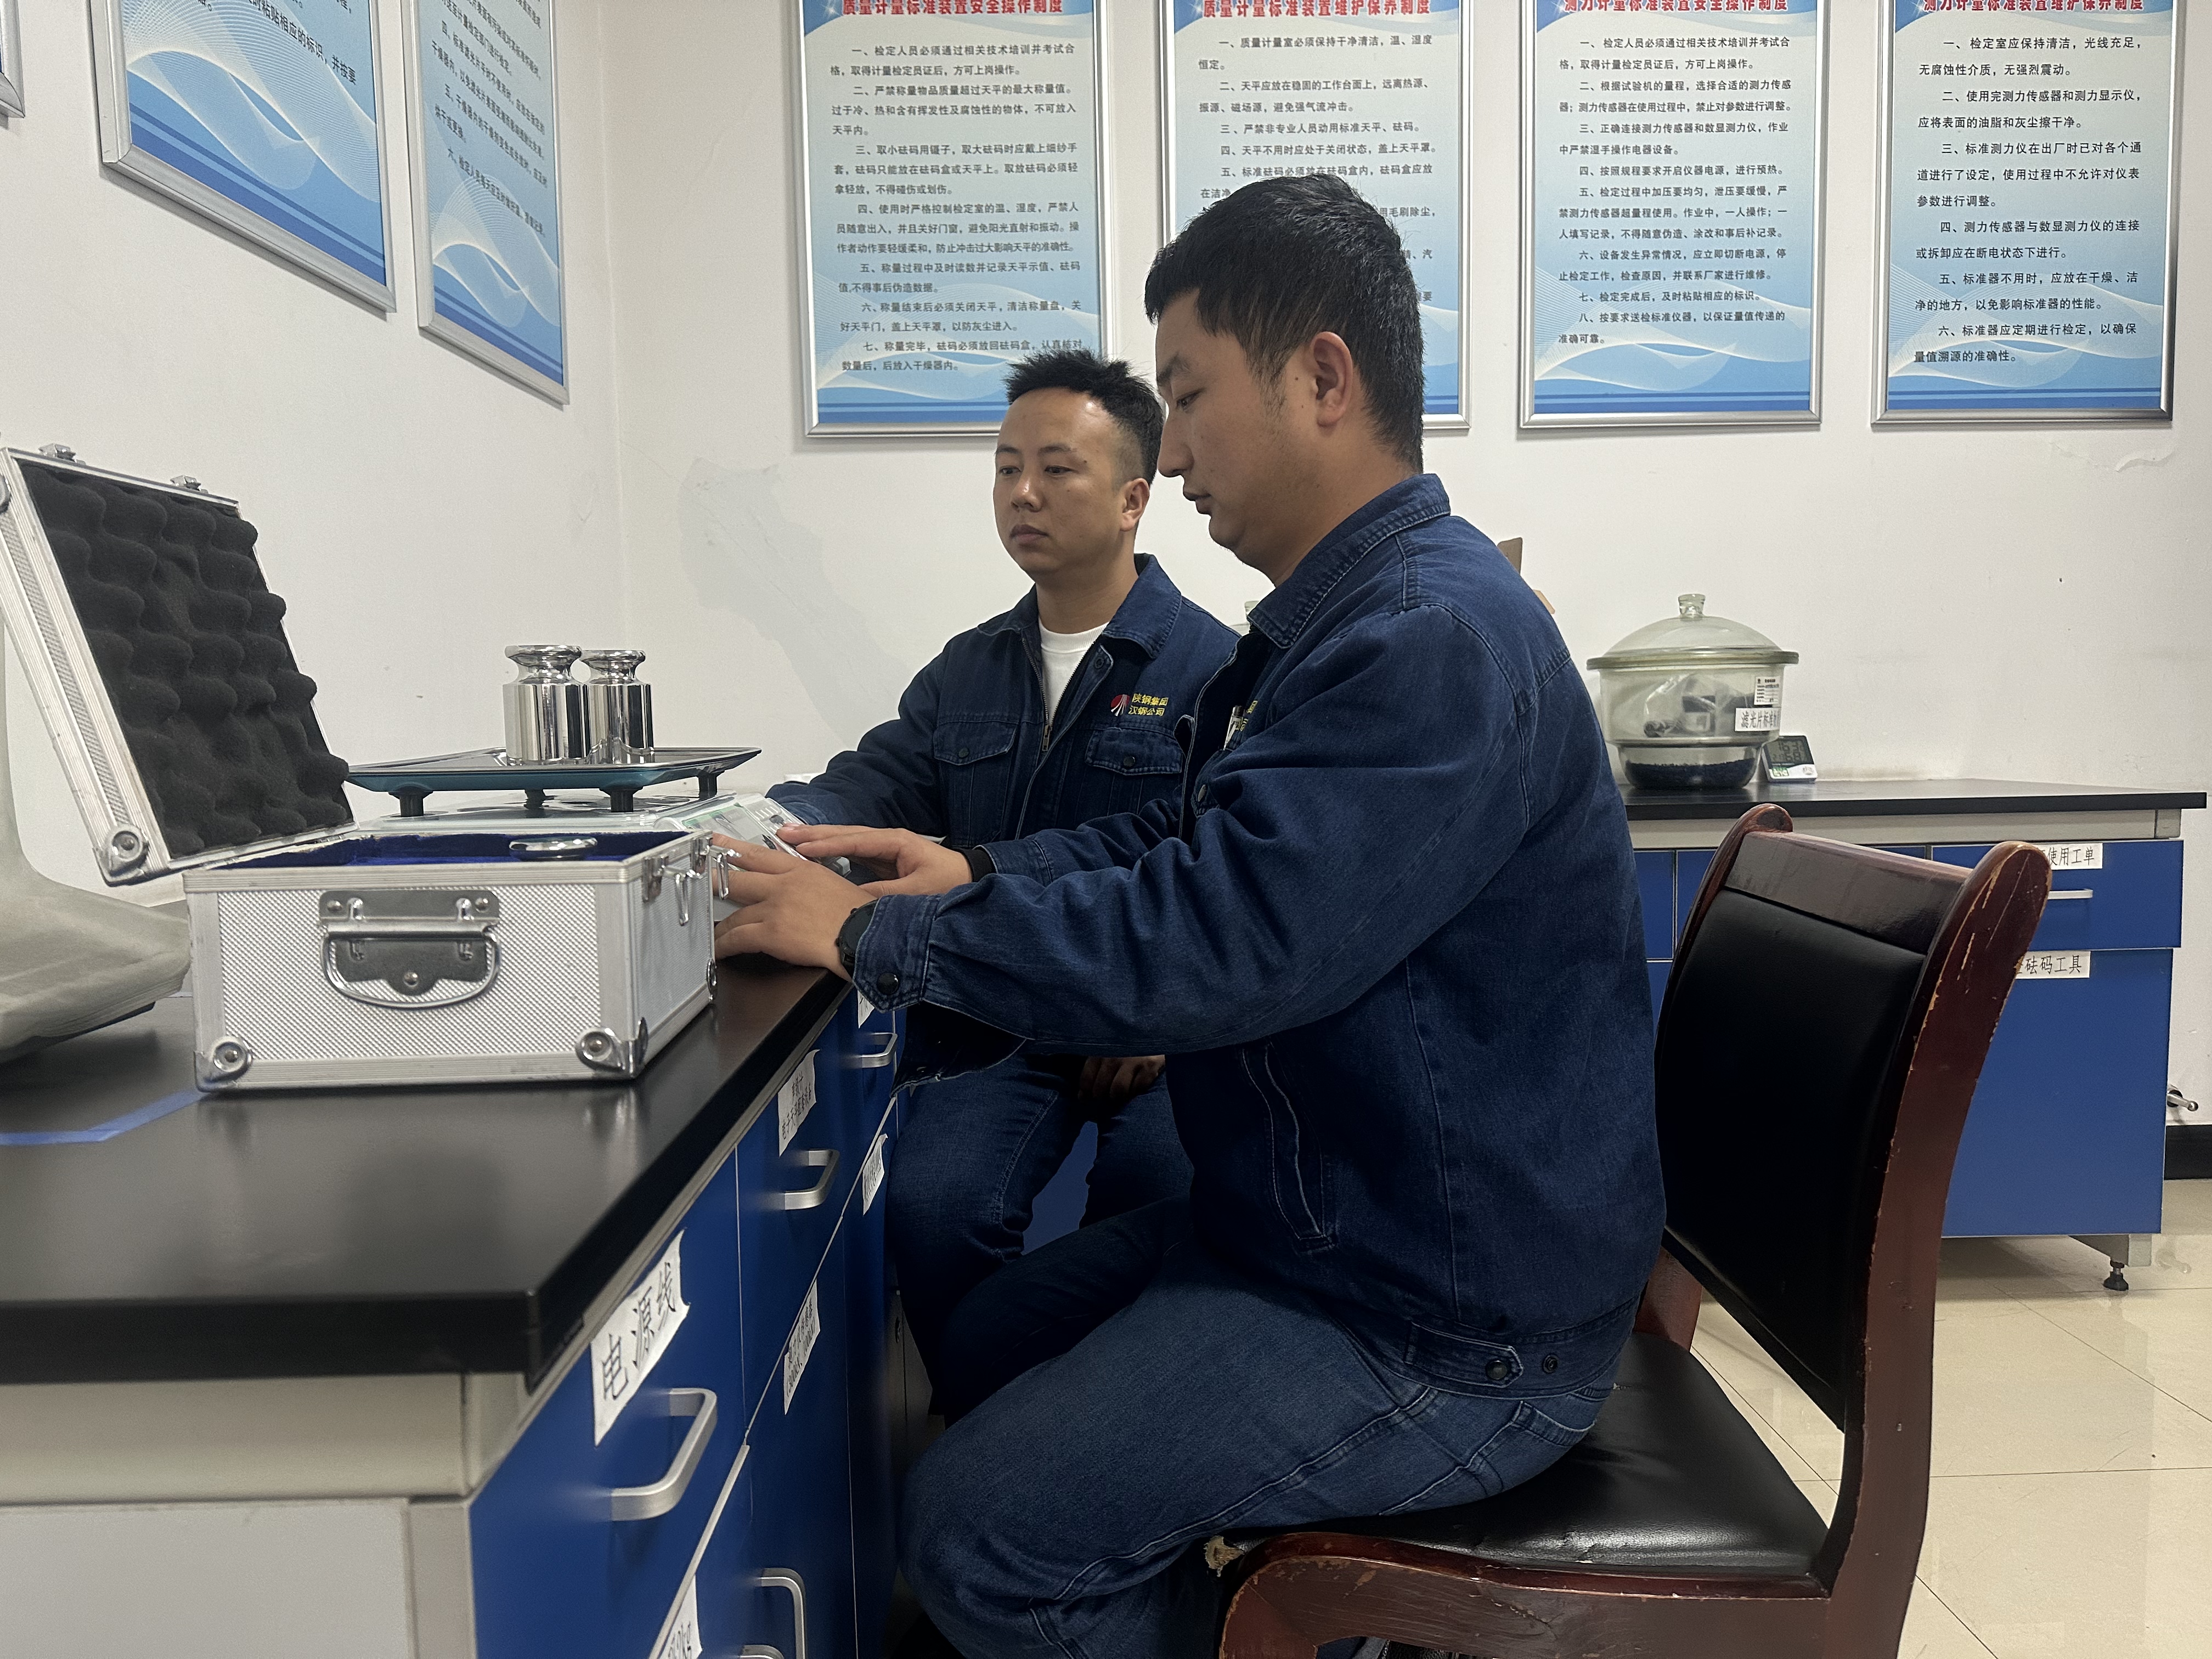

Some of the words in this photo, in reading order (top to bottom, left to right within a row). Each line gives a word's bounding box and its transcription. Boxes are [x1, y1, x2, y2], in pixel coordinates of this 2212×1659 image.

[1943, 36, 2141, 50] 一、检定室应保持清洁，光线充足，
[1198, 59, 1225, 70] 恒定。
[1918, 63, 2070, 76] 无腐蚀性介质，无强烈震动。
[1942, 89, 2140, 103] 二、使用完测力传感器和测力显示仪，
[1917, 116, 2081, 129] 应将表面的油脂和灰尘擦干净。
[832, 125, 868, 136] 天平内。
[1559, 144, 1678, 155] 中严禁湿手操作电器设备。
[1941, 141, 2142, 155] 三、标准测力仪在出厂时已对各个通
[1917, 167, 2140, 182] 道进行了设定，使用过程中不允许对仪表
[1916, 195, 1996, 207] 参数进行调整。
[1940, 219, 2140, 233] 四、测力传感器与数显测力仪的连接
[1916, 246, 2066, 259] 或拆卸应在断电状态下进行。
[1938, 271, 2138, 285] 五、标准器不用时，应放在干燥、洁
[1915, 297, 2102, 312] 净的地方，以免影响标准器的性能。
[1938, 323, 2137, 337] 六、标准器应定期进行检定，以确保
[1558, 334, 1605, 344] 准确可靠。
[1913, 351, 2016, 363] 量值溯源的准确性。
[1131, 693, 1169, 706] 陕钢集团
[1128, 705, 1165, 716] 汉钢公司
[2040, 846, 2094, 866] 使用工单
[2017, 955, 2082, 974] 砝码工具
[602, 1261, 676, 1400] 电源线
